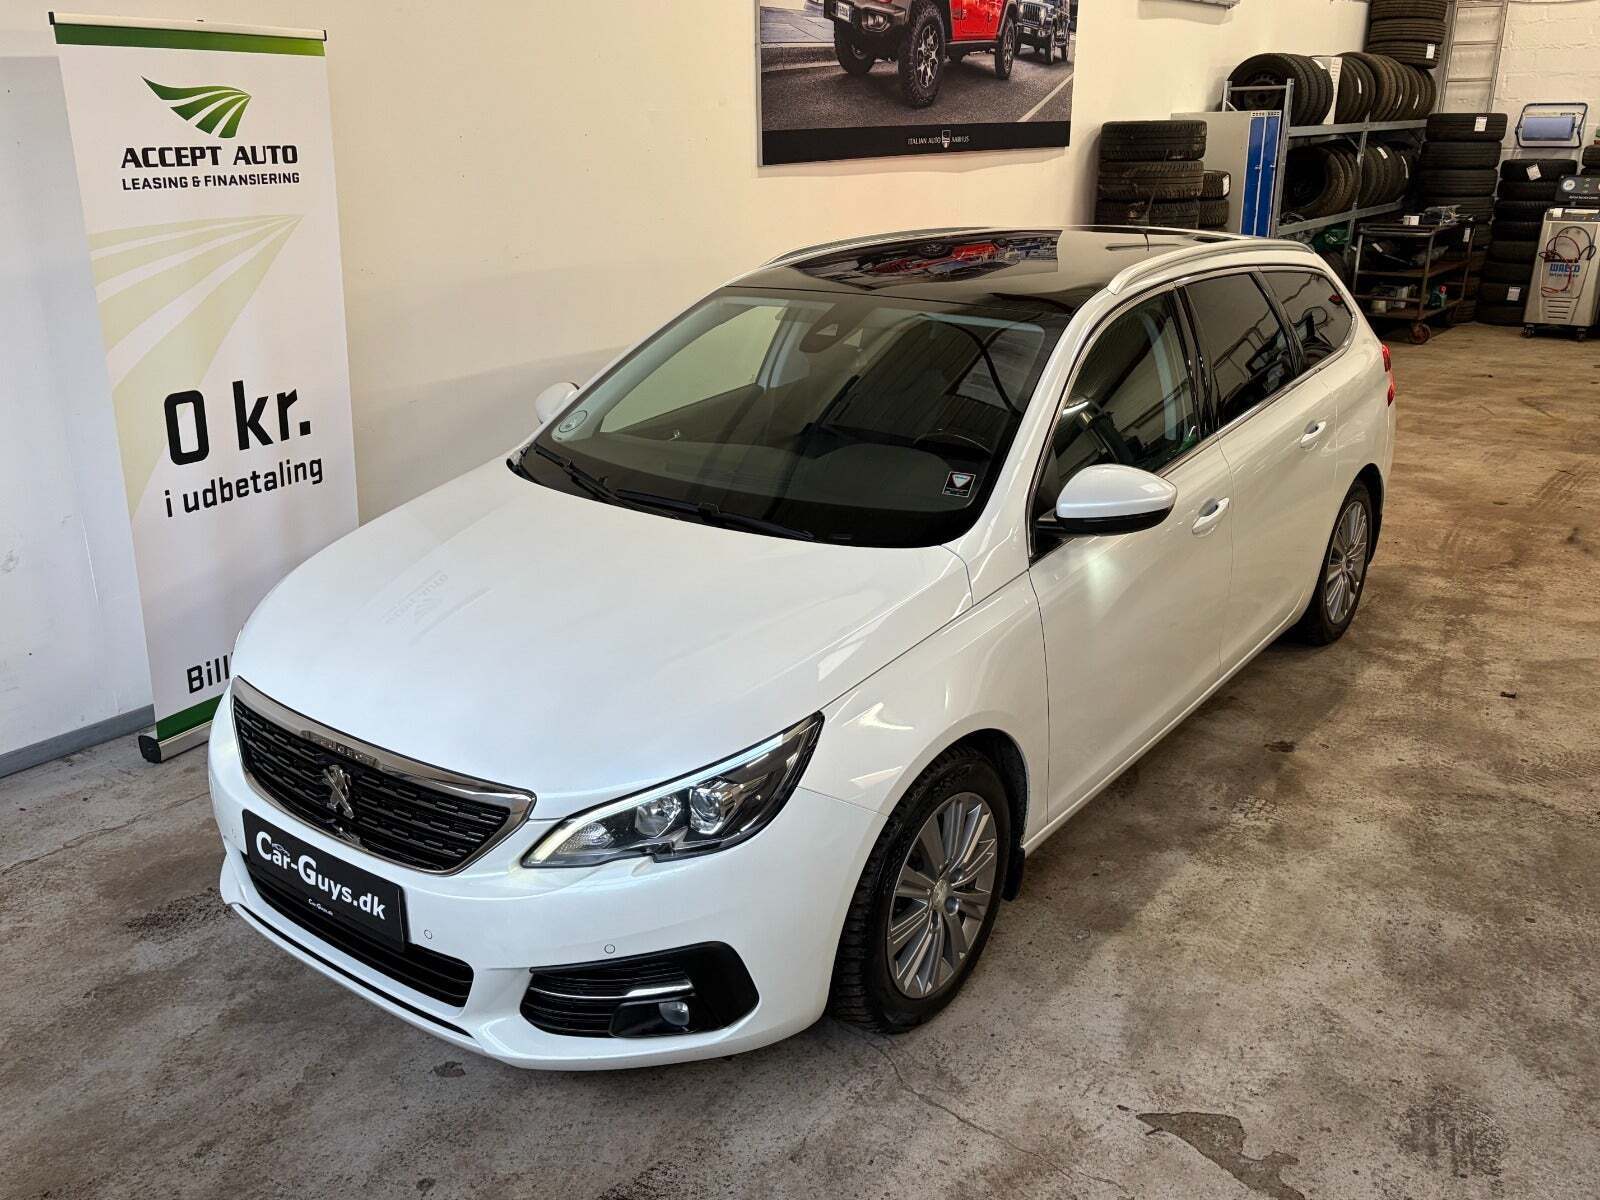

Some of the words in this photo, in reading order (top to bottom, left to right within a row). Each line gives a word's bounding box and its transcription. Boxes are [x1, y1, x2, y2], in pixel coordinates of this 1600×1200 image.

[121, 146, 222, 168] ACCEPT
[233, 145, 298, 165] AUTO
[122, 176, 188, 190] LEASING
[192, 176, 201, 187] &
[204, 172, 300, 187] FINANSIERING
[164, 390, 210, 465] 0
[232, 380, 311, 450] kr.
[165, 490, 173, 517] i
[182, 458, 324, 513] udbetaling
[186, 651, 233, 694] Bill
[256, 831, 386, 920] Car-Guys.dk
